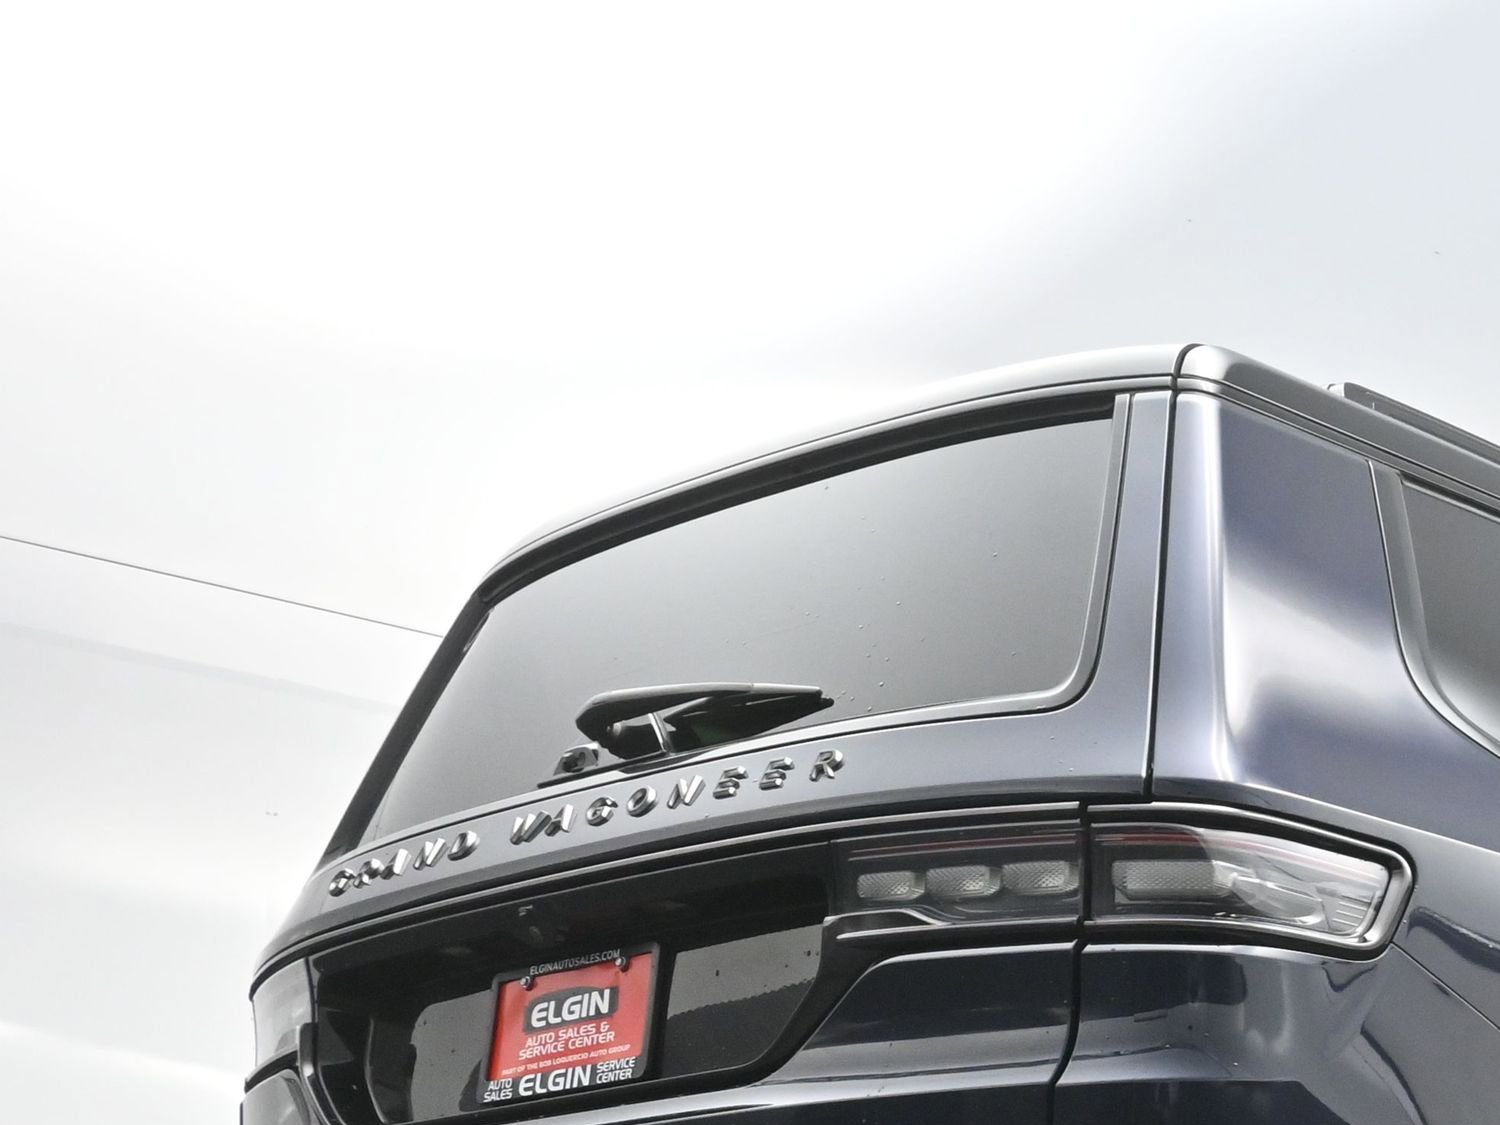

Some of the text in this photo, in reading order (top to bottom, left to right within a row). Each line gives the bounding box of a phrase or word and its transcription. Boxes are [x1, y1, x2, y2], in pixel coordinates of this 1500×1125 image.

[328, 748, 845, 898] GRAND WAGONEER
[530, 949, 621, 975] ELGINAUTOSALES.COM
[531, 989, 610, 1028] ELGIN
[518, 1031, 615, 1061] SERVICE CENTER
[526, 1022, 610, 1048] AUTO SALES &
[589, 1049, 608, 1058] AUTO
[608, 1044, 631, 1055] GROUP
[596, 1056, 636, 1073] SERVICE
[596, 1068, 633, 1084] CENTER
[488, 1078, 512, 1091] AUTO
[518, 1064, 592, 1097] ELGIN
[483, 1089, 512, 1103] SALES
